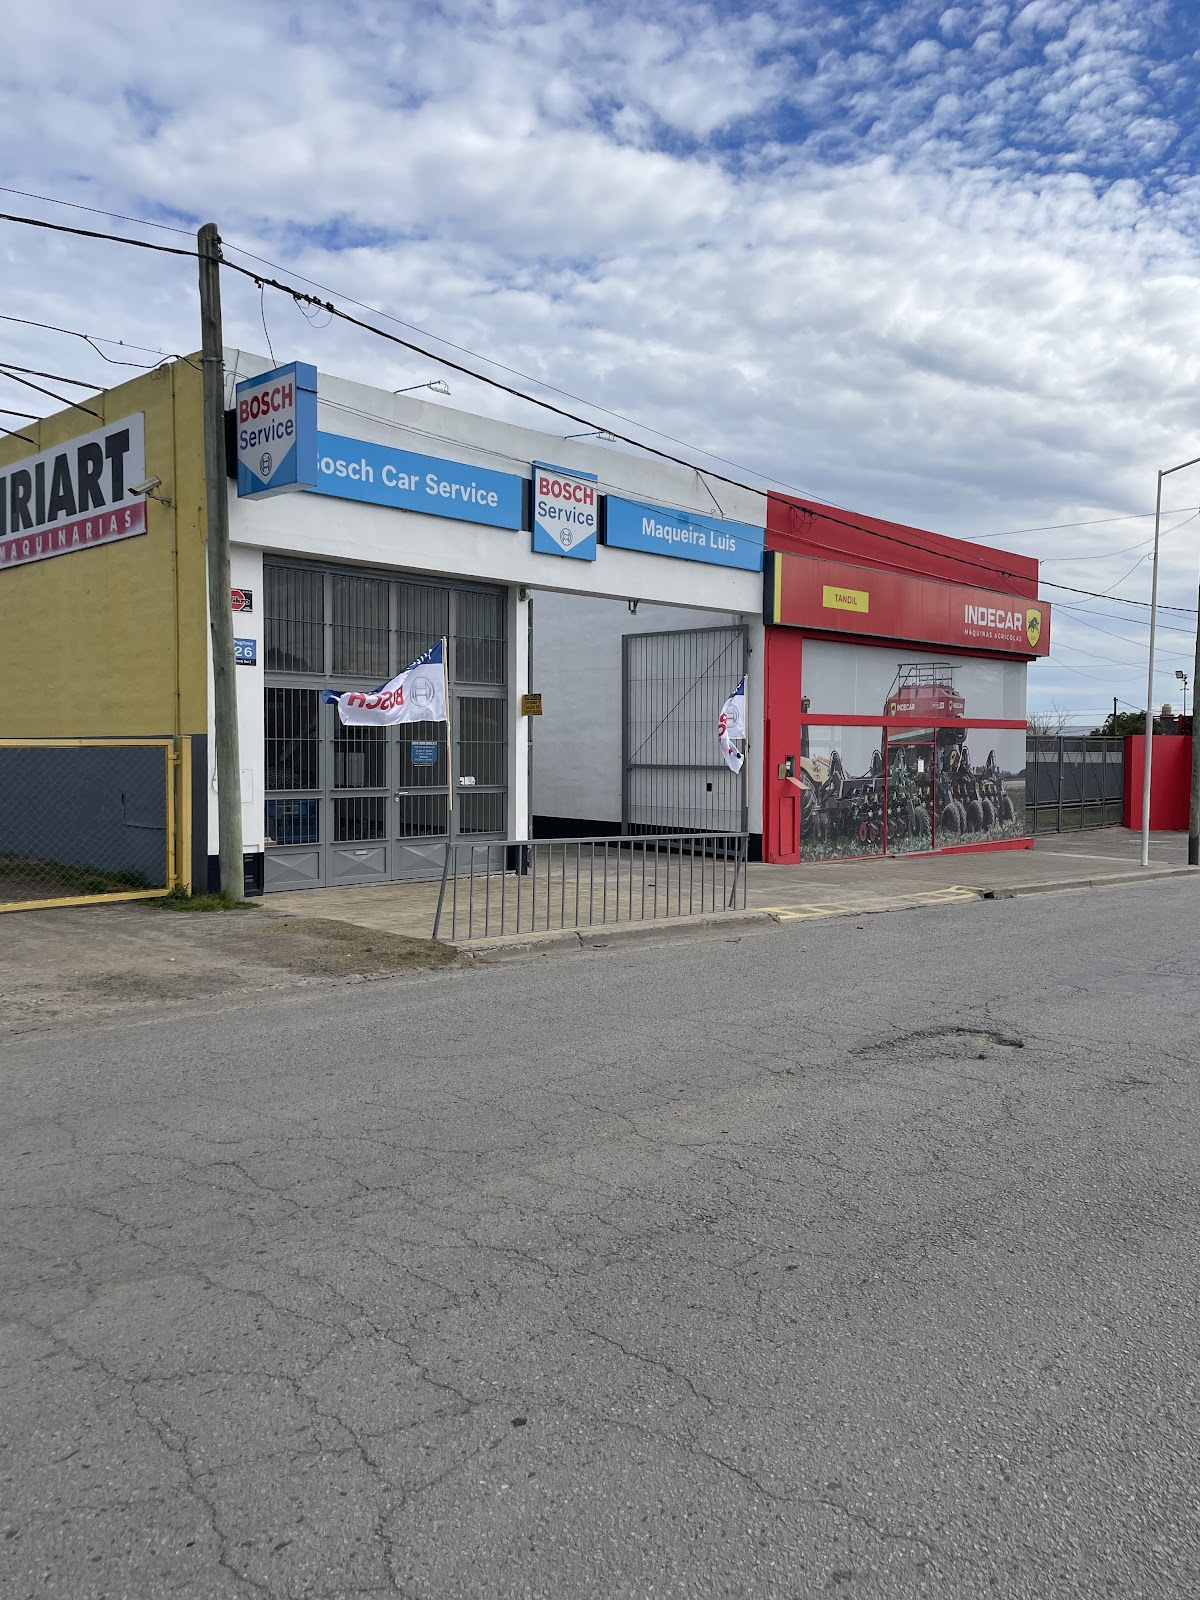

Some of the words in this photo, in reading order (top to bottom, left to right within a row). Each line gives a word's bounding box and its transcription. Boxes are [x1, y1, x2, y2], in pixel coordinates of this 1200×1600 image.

[240, 383, 293, 424] BOSCH
[240, 419, 294, 450] Service
[317, 452, 374, 483] osch
[382, 465, 419, 491] Car
[425, 474, 498, 507] Service
[539, 477, 594, 506] BOSCH
[538, 501, 594, 526] Service
[642, 517, 706, 544] Maqueira
[710, 531, 736, 552] Luis
[834, 593, 858, 605] TANDIL
[964, 604, 1023, 631] INDECAR
[234, 646, 253, 658] 26
